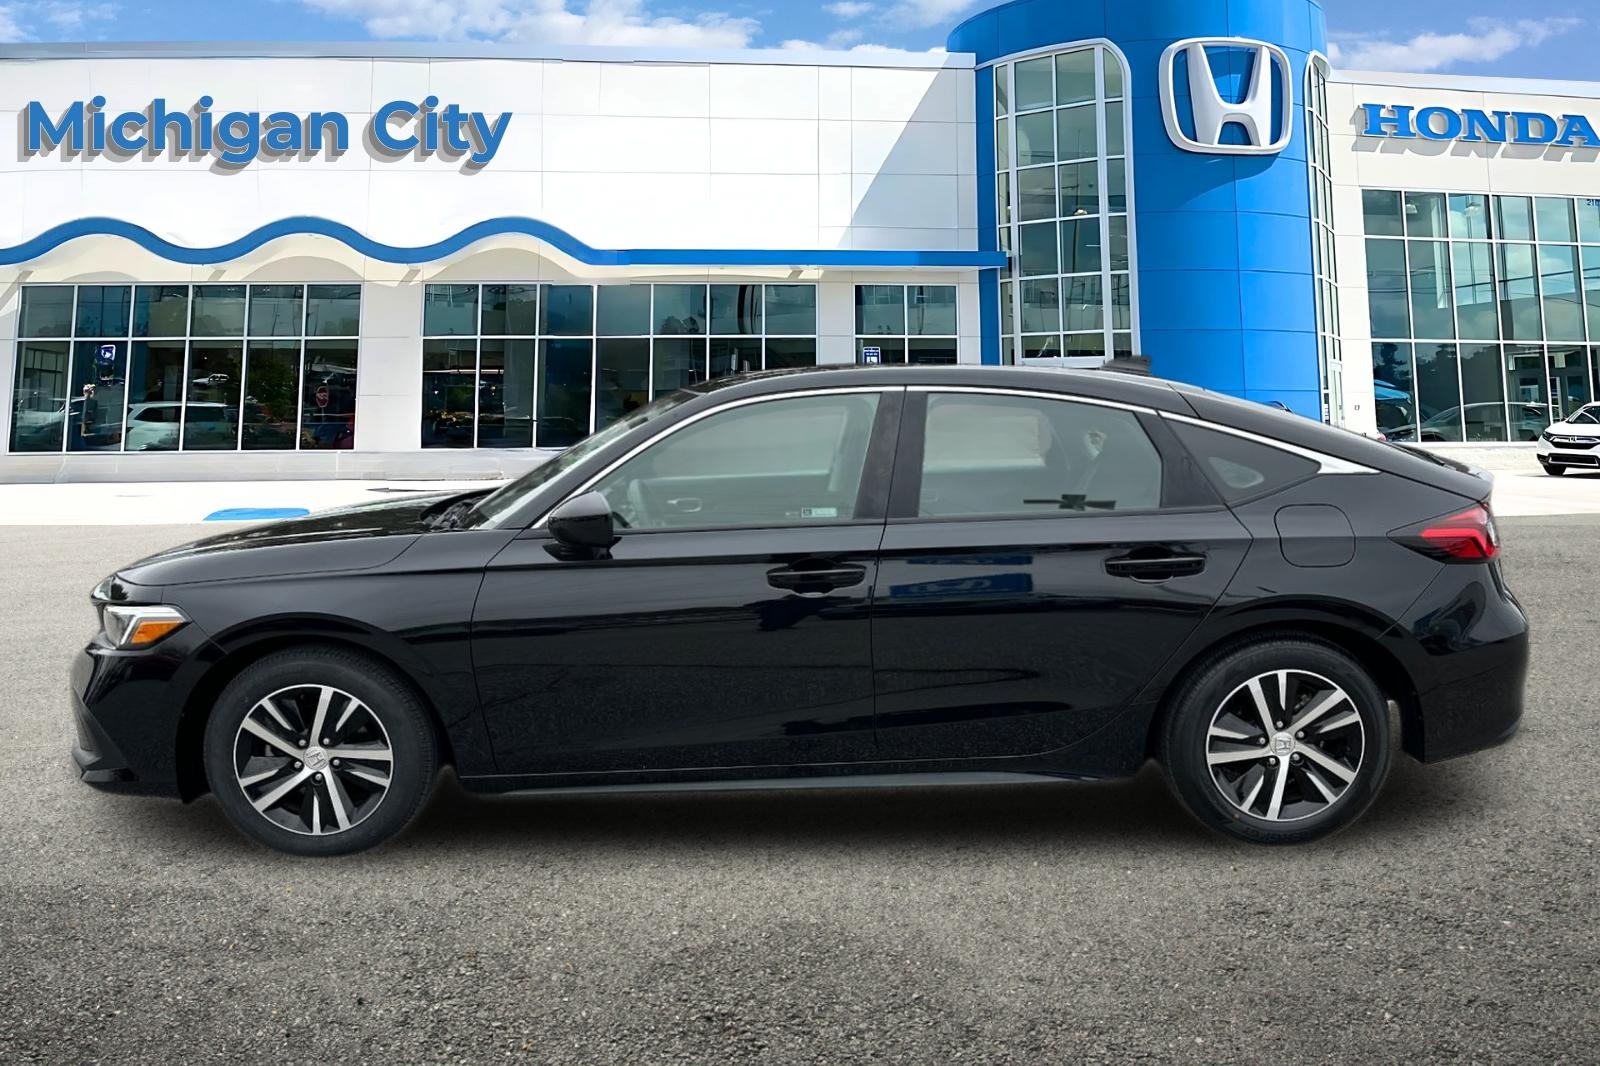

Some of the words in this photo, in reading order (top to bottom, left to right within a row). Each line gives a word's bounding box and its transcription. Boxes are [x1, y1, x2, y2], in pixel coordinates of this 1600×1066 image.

[28, 95, 349, 165] Michigan
[373, 95, 513, 165] City
[1362, 102, 1600, 148] HONDA
